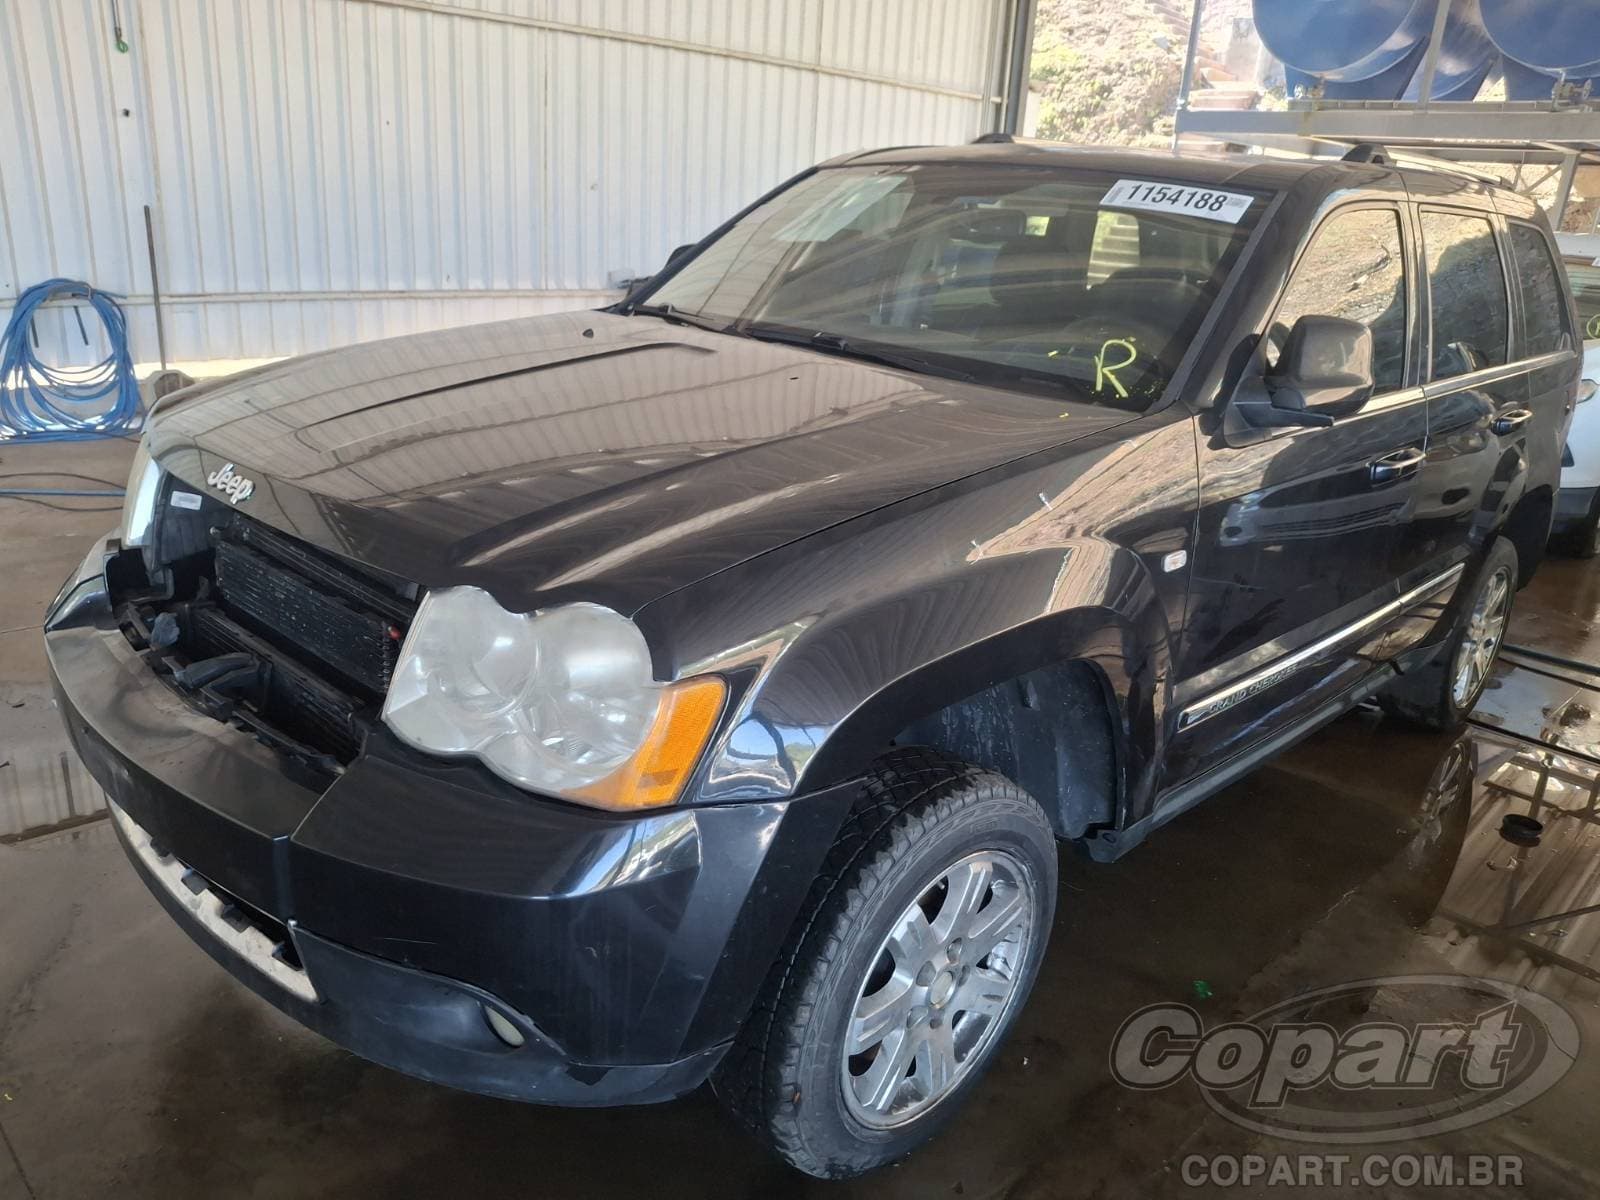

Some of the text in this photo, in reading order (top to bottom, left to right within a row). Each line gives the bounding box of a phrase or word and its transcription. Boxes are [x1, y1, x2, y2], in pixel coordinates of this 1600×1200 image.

[1127, 184, 1228, 212] 1154188
[1095, 338, 1137, 398] R
[207, 463, 255, 505] Jeep
[1209, 689, 1248, 712] GRAND
